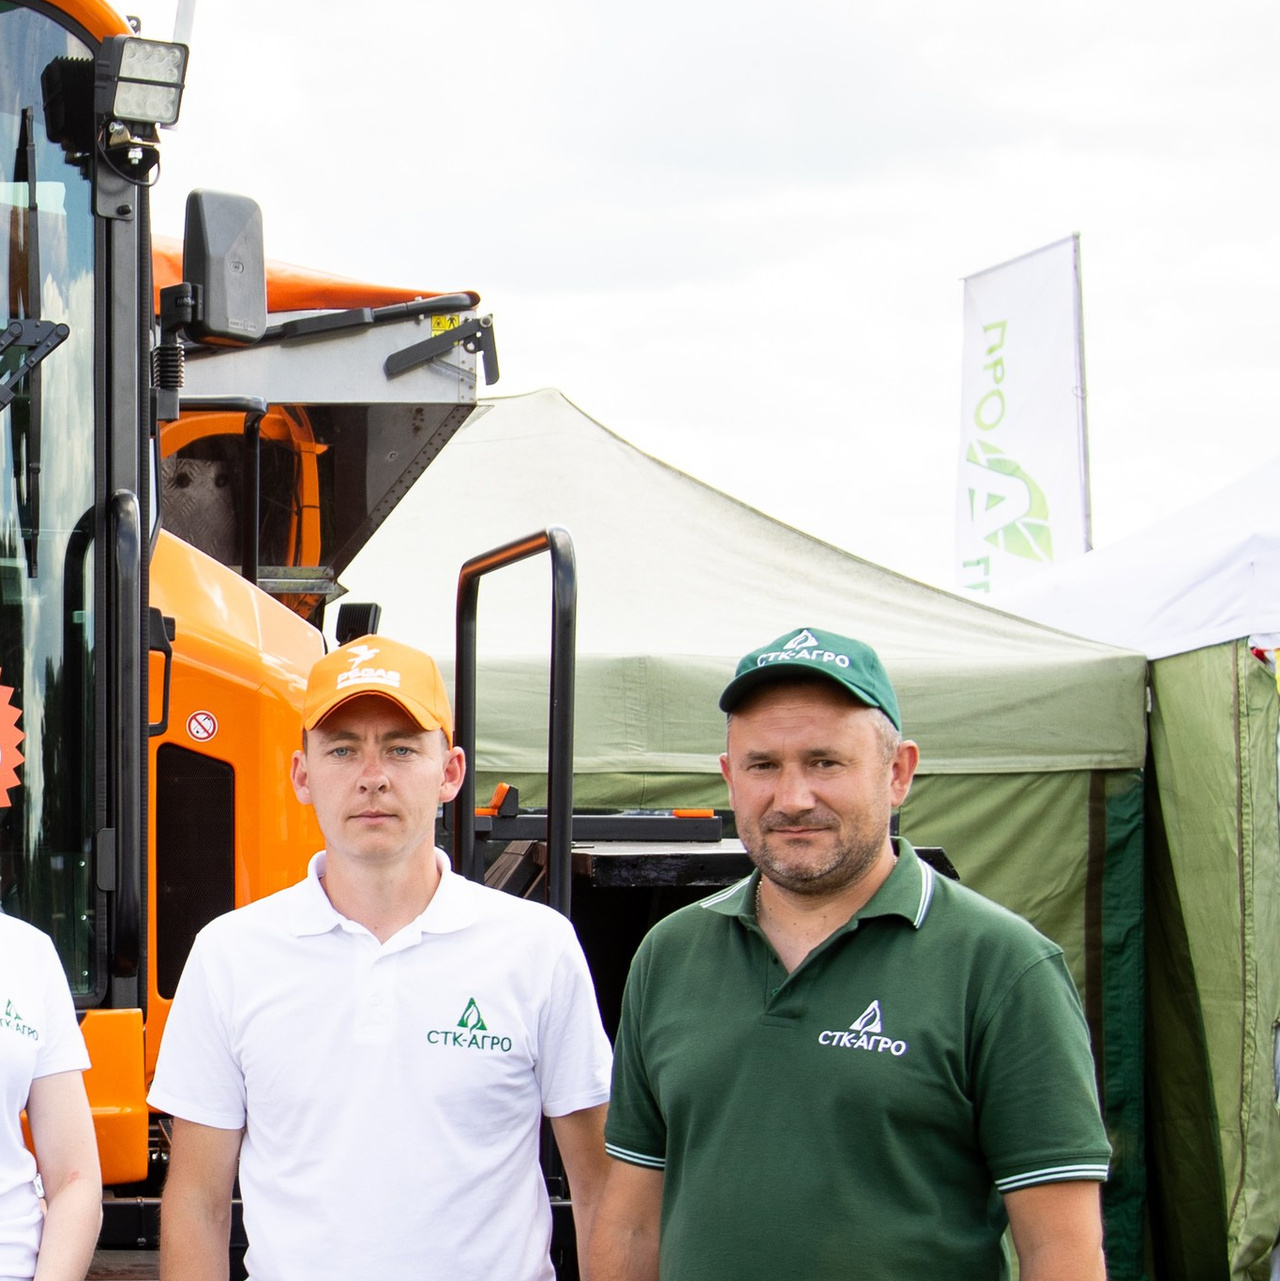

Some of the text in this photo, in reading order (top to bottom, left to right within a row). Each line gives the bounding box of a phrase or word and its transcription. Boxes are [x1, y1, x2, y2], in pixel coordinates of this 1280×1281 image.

[757, 649, 850, 668] СТК-АГРО
[427, 1030, 512, 1052] СТК-АГРО
[818, 1030, 907, 1056] СТК-АГРО
